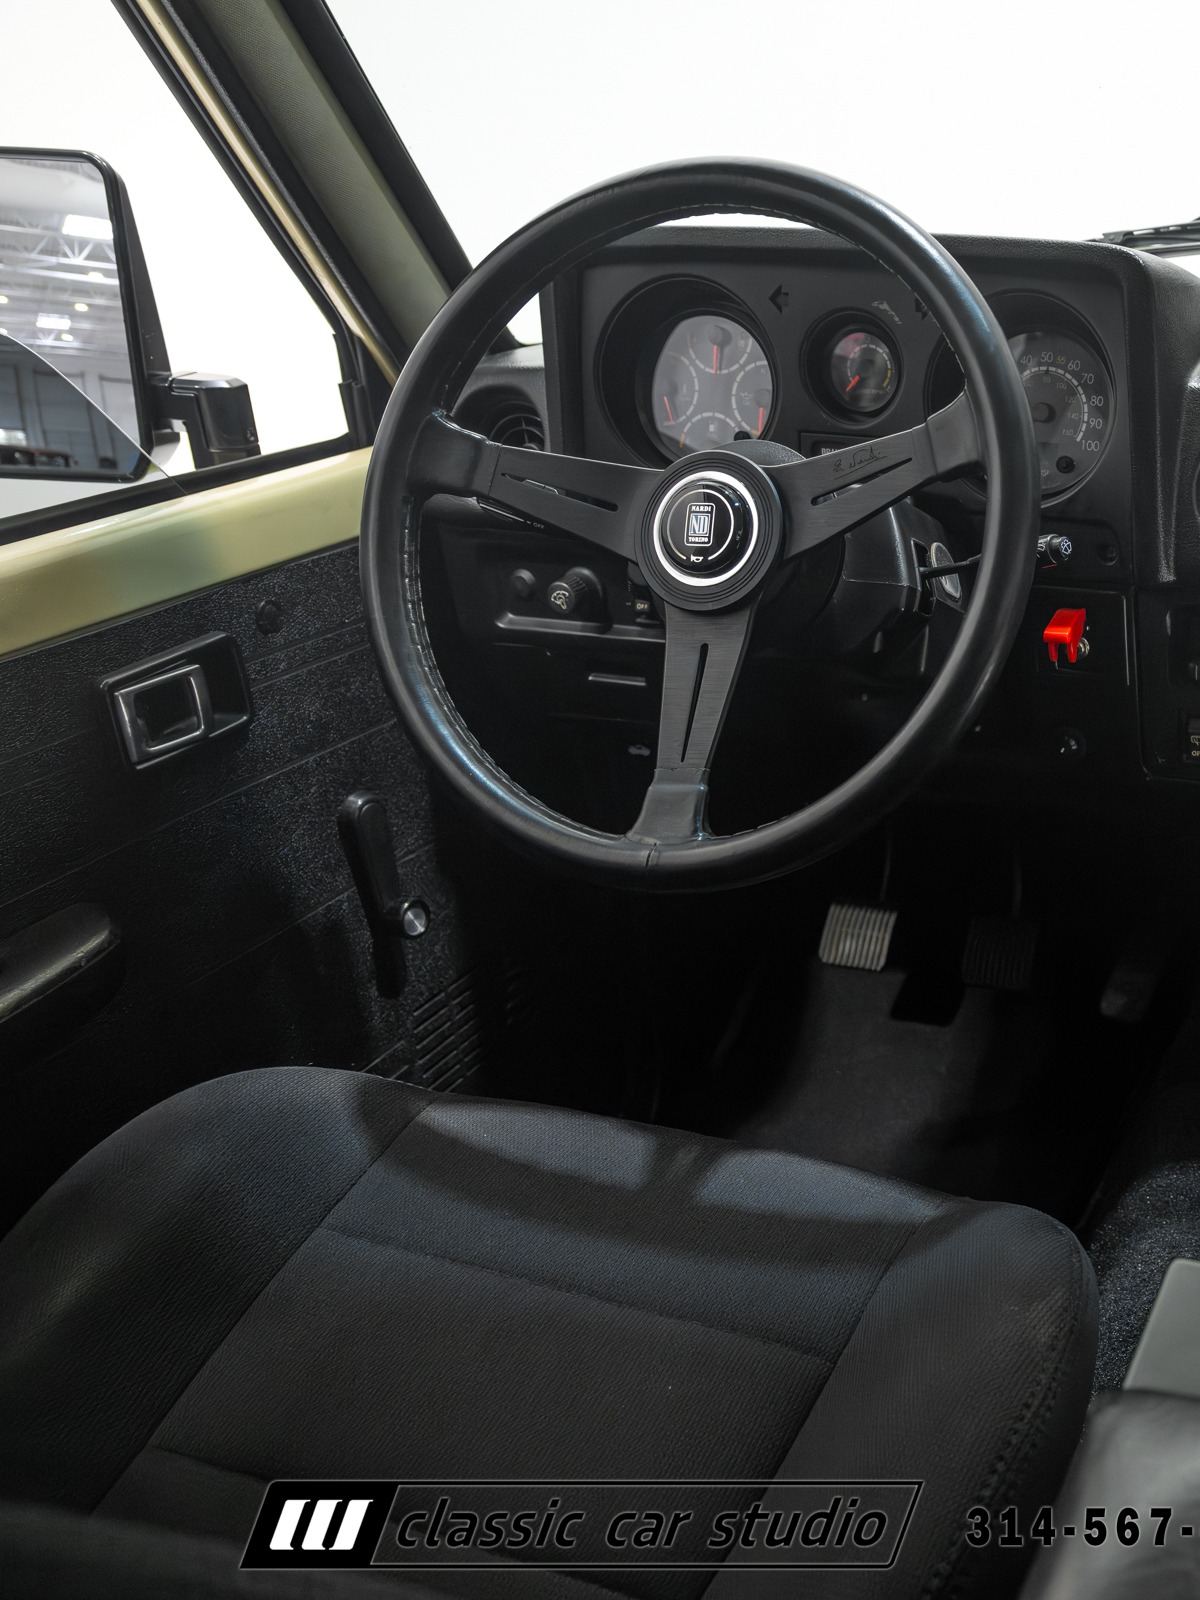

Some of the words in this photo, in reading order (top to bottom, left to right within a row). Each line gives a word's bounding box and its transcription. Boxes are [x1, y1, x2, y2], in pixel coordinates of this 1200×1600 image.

[1020, 355, 1033, 366] 40
[1040, 352, 1053, 363] 50
[1056, 356, 1066, 365] 55
[1067, 360, 1081, 371] 60
[1081, 373, 1094, 384] 70
[1089, 395, 1104, 407] 80
[1089, 418, 1103, 429] 90
[1081, 440, 1100, 452] 100
